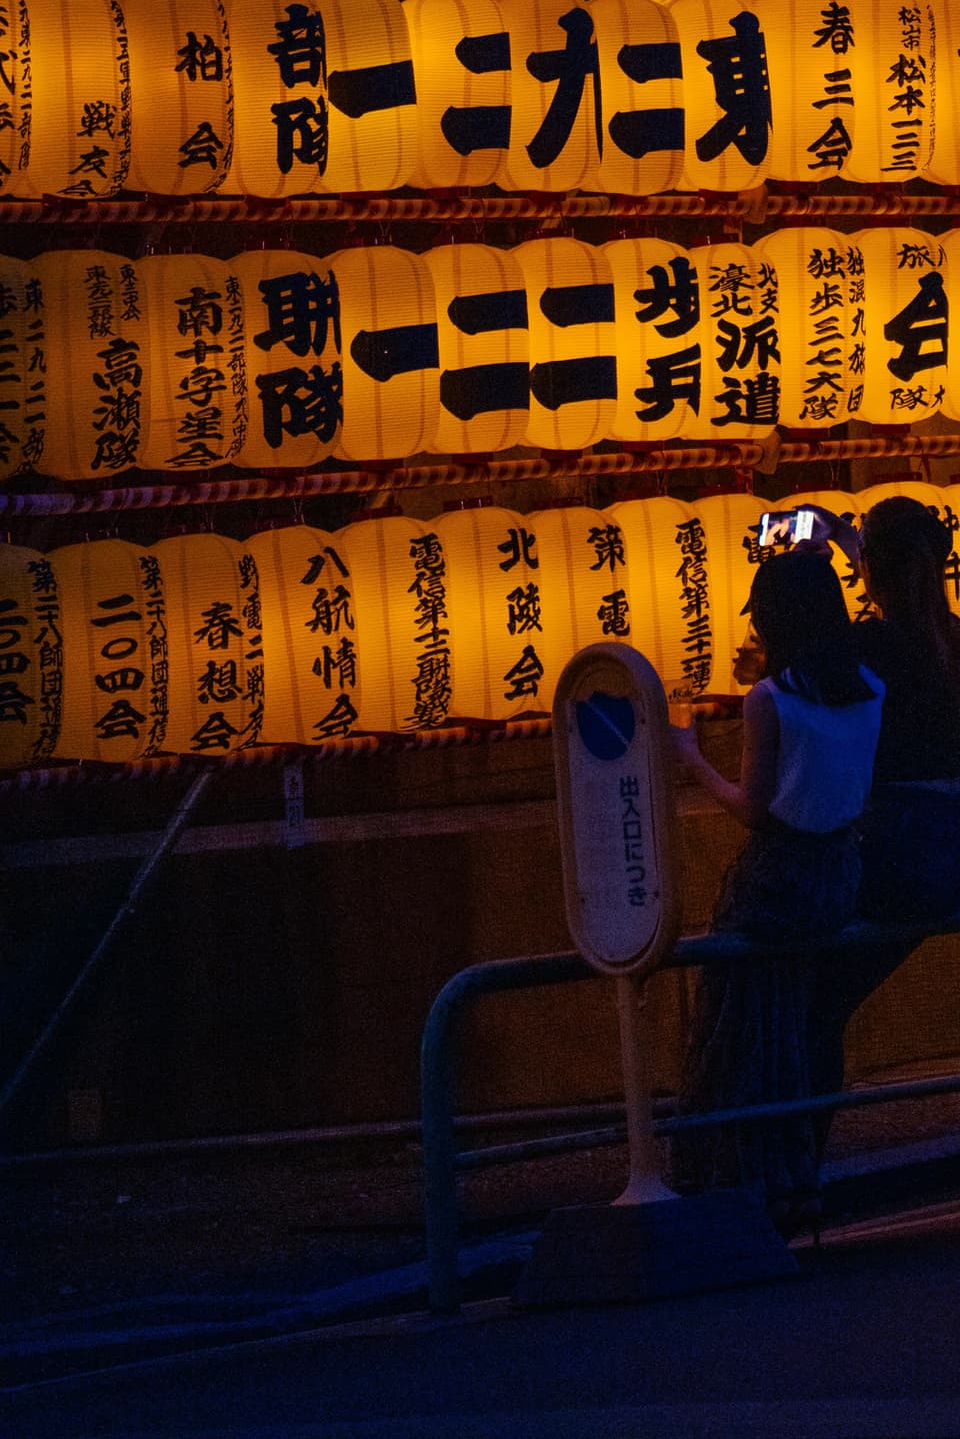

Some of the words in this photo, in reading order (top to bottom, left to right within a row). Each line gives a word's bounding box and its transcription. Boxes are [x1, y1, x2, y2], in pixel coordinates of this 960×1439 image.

[58, 100, 118, 199] 戦友会
[173, 30, 224, 171] 柏会
[804, 3, 856, 170] 春三会
[91, 593, 146, 740] 二〇四会
[620, 775, 647, 907] 出入口につき
